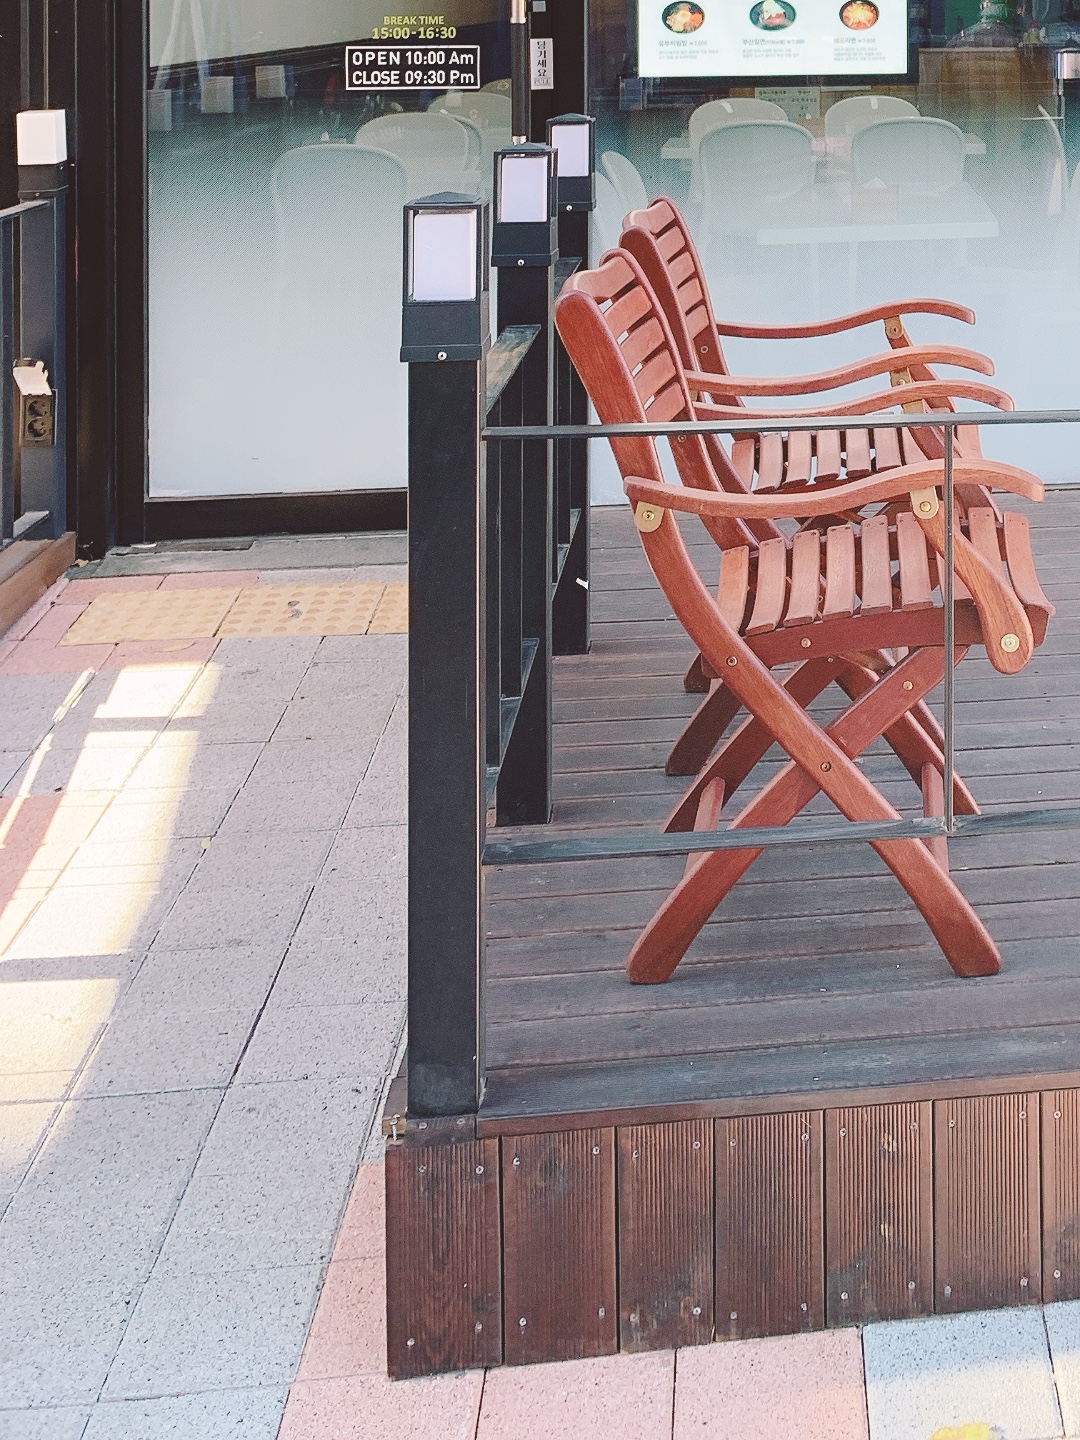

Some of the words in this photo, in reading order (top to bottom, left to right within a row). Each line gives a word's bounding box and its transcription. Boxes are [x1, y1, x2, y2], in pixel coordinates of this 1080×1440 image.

[383, 16, 416, 26] BREAK
[418, 16, 445, 26] TIME
[352, 51, 401, 65] OPEN
[405, 51, 446, 65] 10:00
[448, 51, 474, 65] Am
[352, 71, 400, 85] CLOSE
[404, 71, 446, 85] 09:30
[450, 71, 474, 85] Pm
